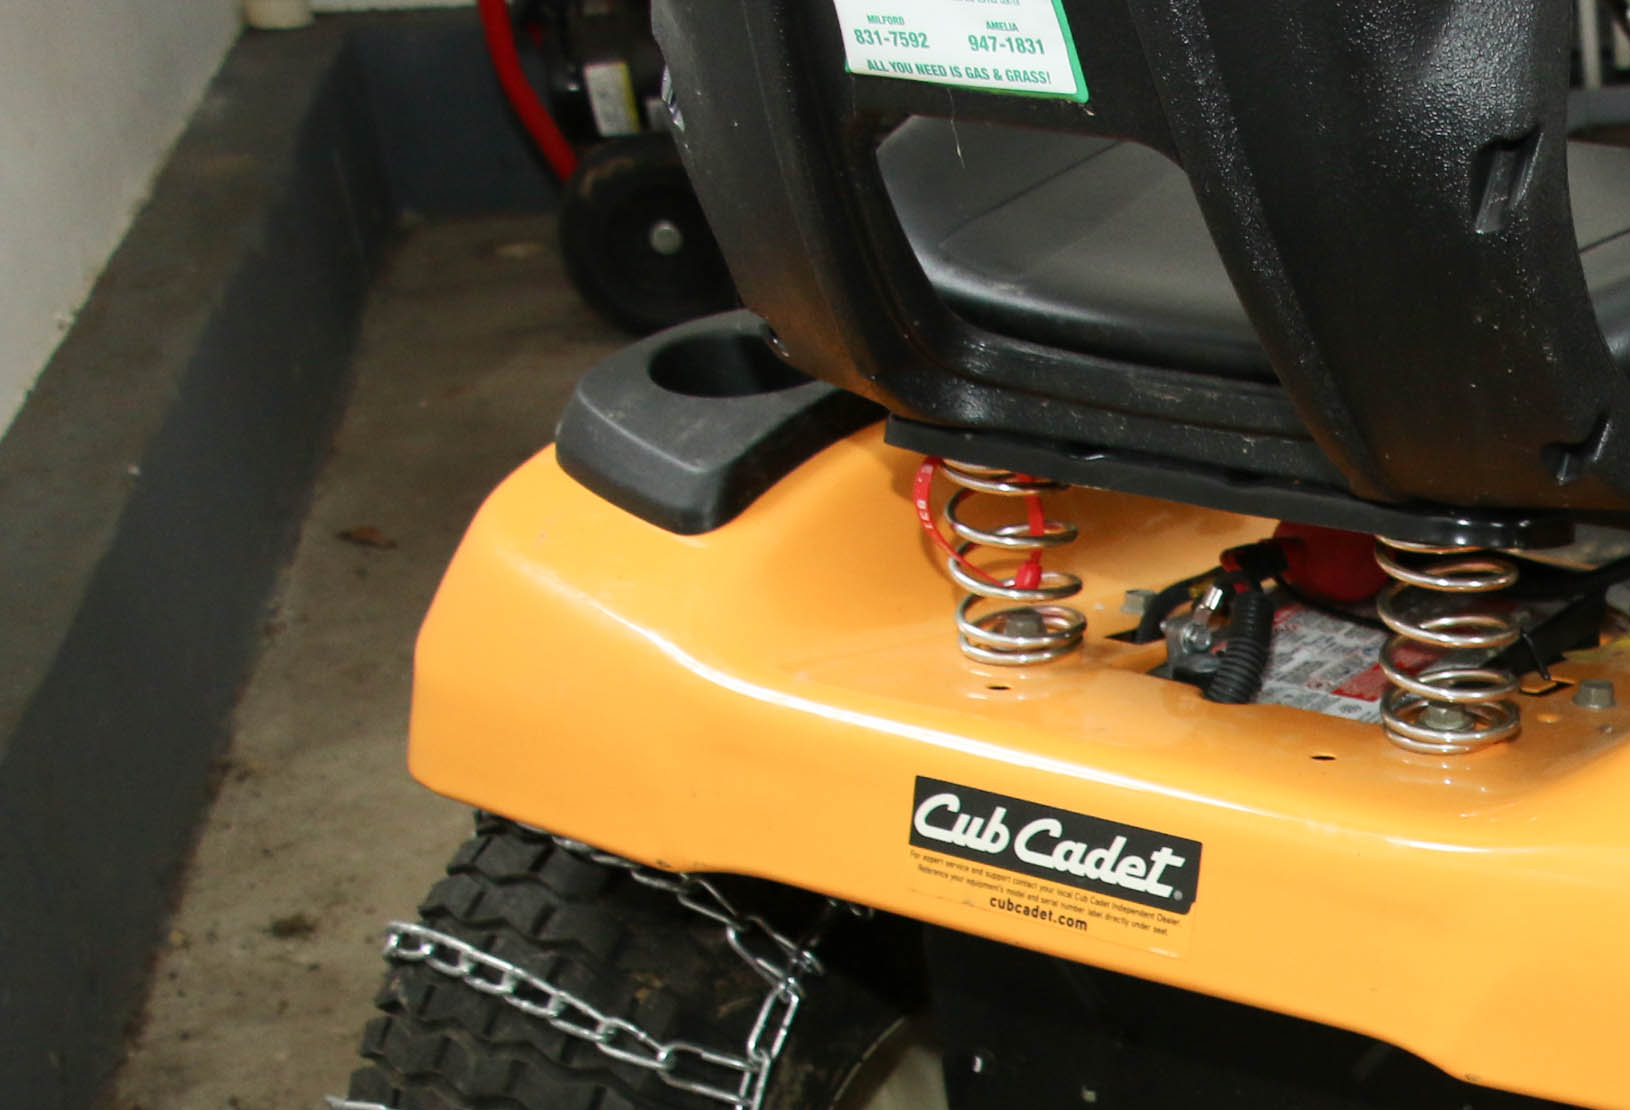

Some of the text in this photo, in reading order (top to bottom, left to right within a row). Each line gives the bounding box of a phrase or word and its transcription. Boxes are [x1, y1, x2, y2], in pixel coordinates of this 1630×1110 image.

[867, 15, 905, 26] MILFORD
[986, 21, 1019, 32] AMELIA
[854, 29, 930, 49] 831-7592
[968, 35, 1045, 55] 947-1831
[867, 59, 1052, 84] ALL YOU NEED IS GAS & GRASS!
[914, 793, 1185, 898] Cub Cadet
[990, 896, 1088, 931] cubcadet.com
